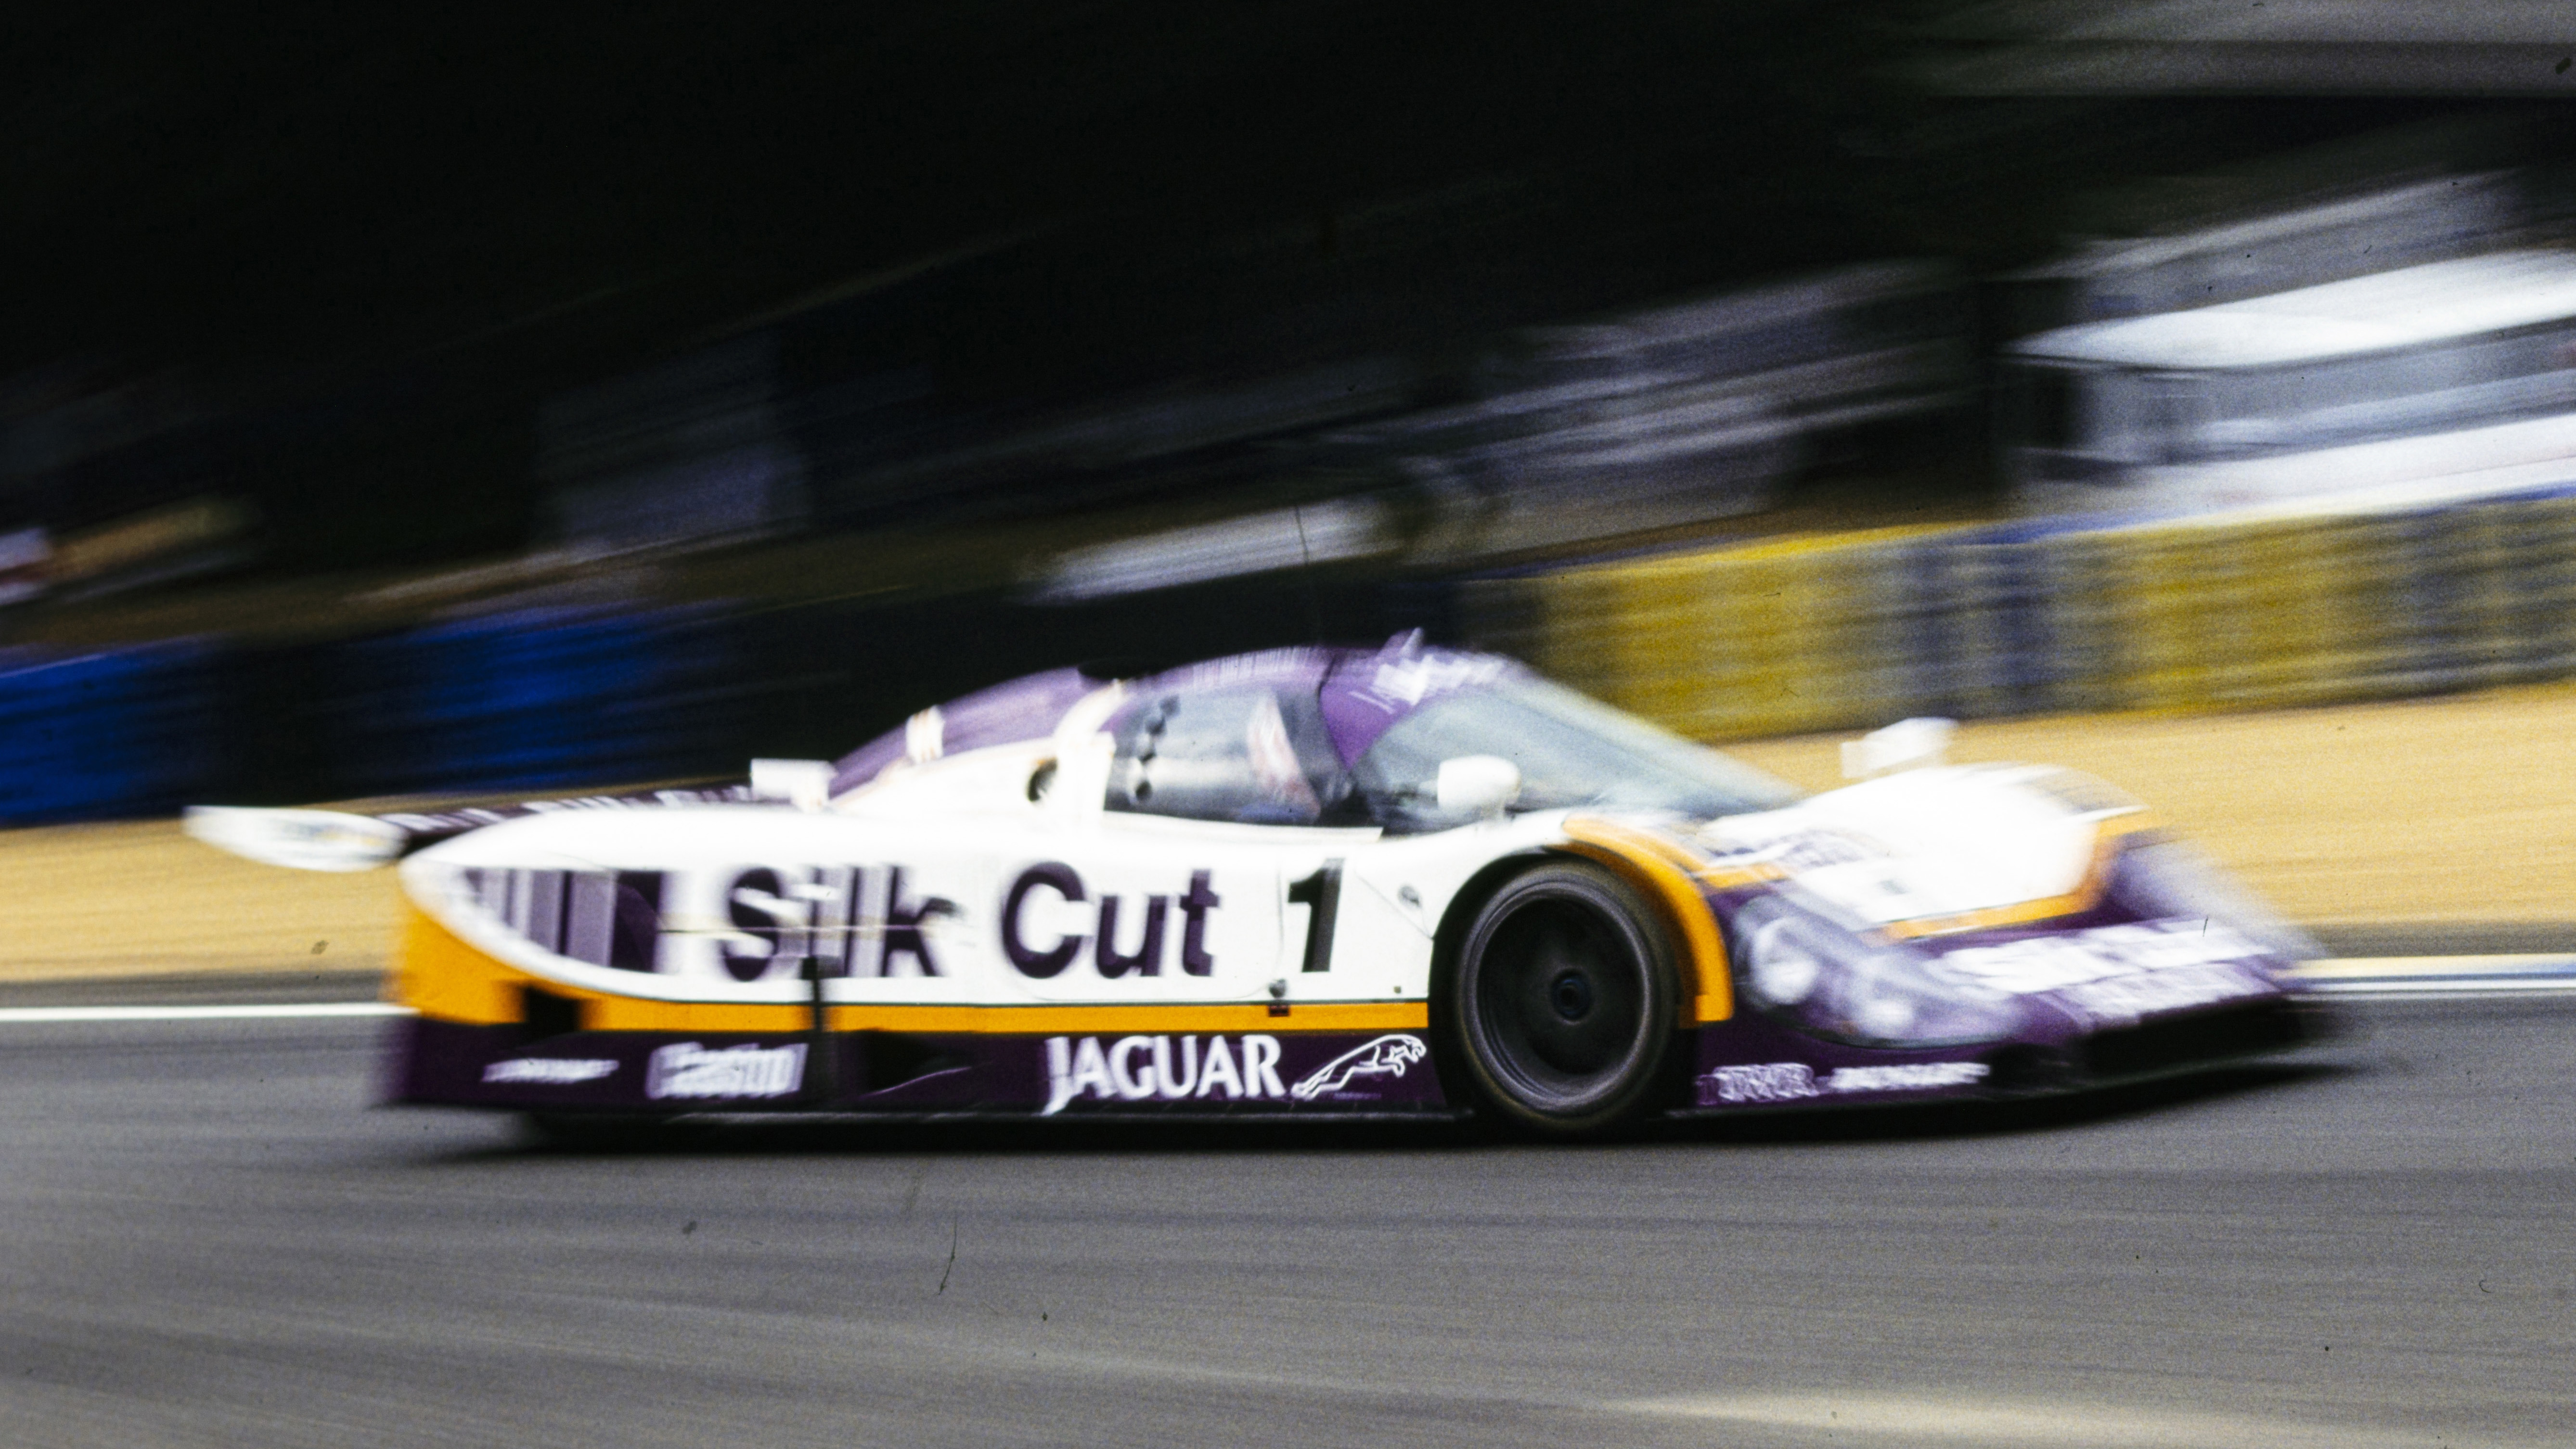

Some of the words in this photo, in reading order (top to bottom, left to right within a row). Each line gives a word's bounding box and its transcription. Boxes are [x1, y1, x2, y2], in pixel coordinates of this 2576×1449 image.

[719, 864, 960, 983] Silk
[1000, 860, 1219, 979] Cut
[1288, 858, 1345, 973] 1
[1033, 1035, 1287, 1116] JAGUAR
